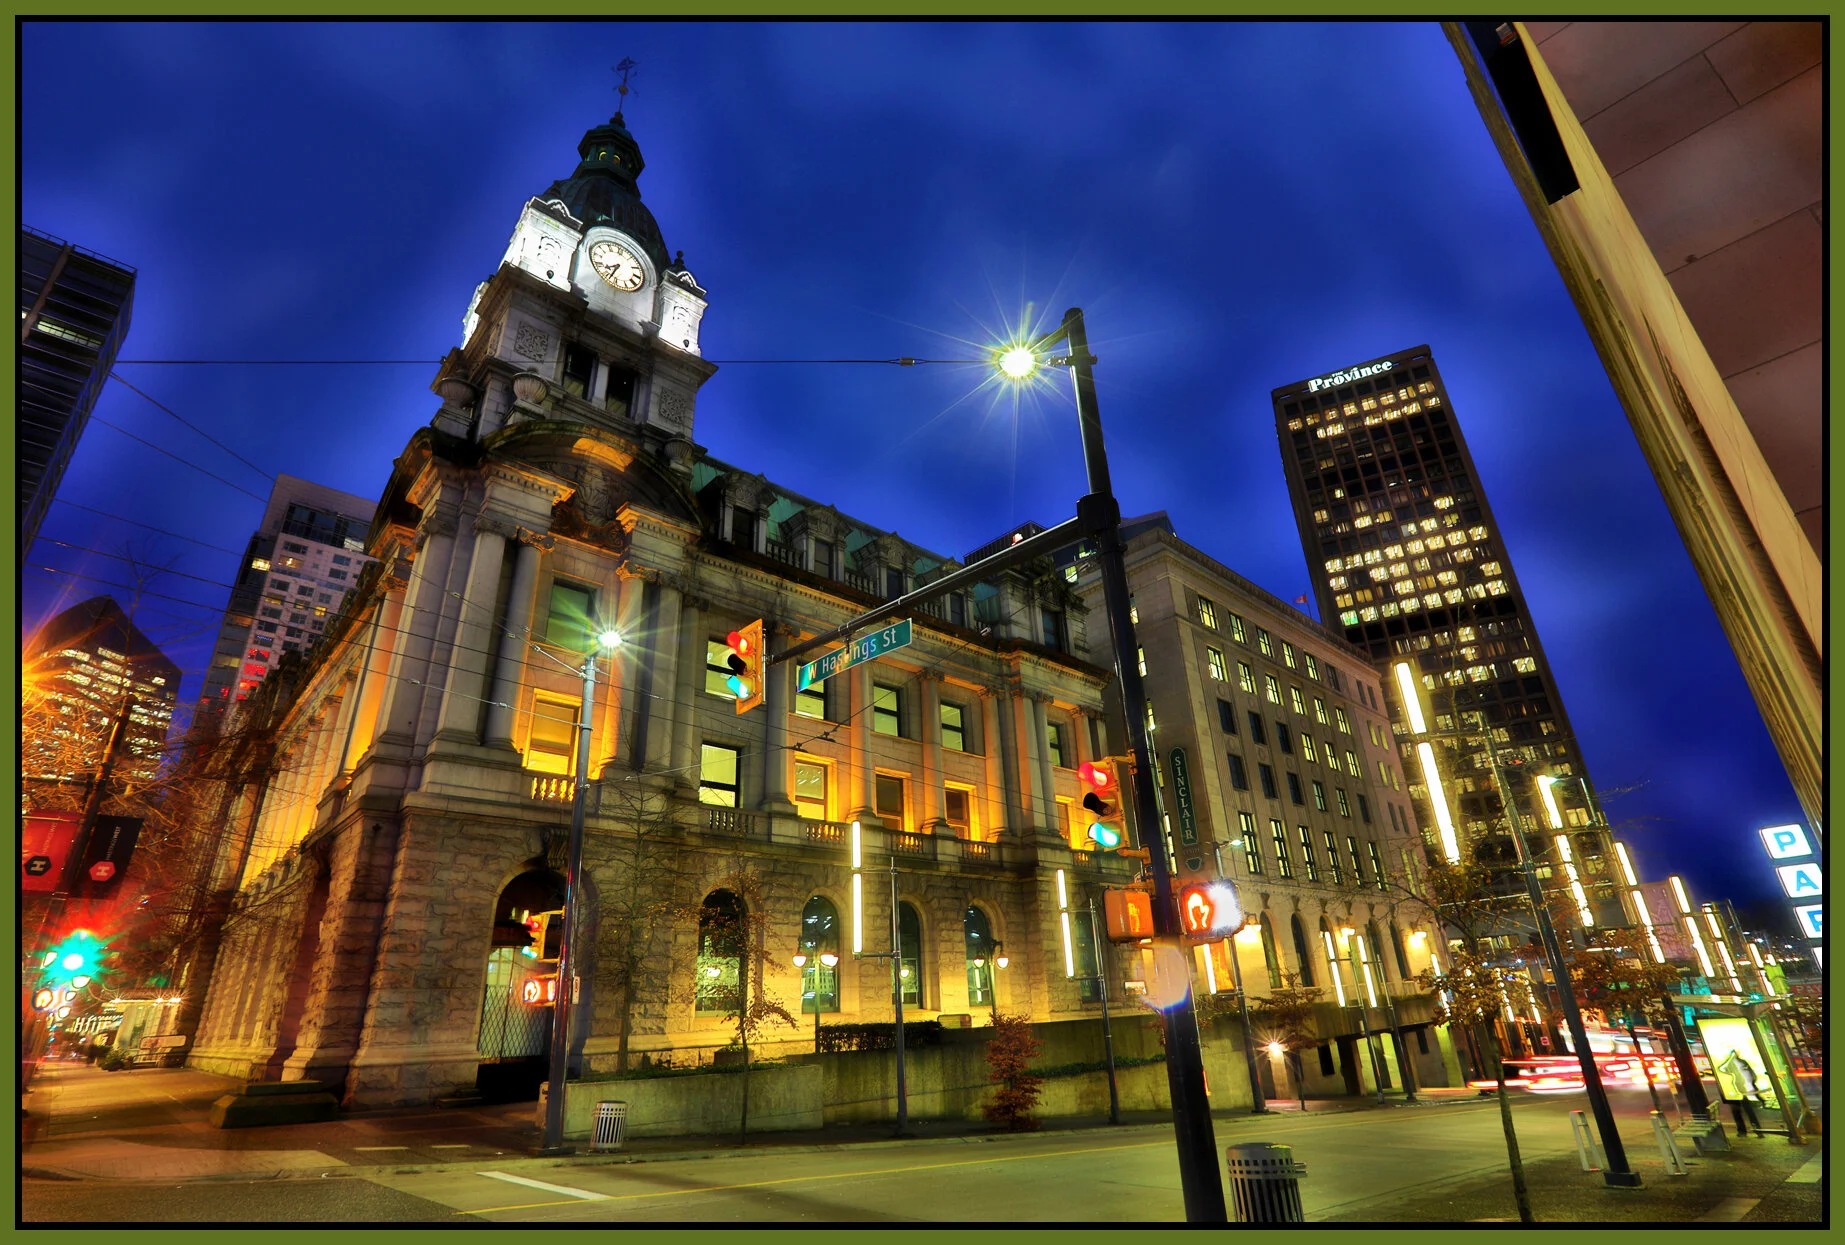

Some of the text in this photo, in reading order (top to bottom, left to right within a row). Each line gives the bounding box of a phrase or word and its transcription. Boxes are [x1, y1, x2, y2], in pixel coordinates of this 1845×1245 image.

[1308, 361, 1393, 393] Province
[807, 663, 817, 681] W
[883, 628, 896, 648] St
[1175, 756, 1194, 840] SINCLAIR
